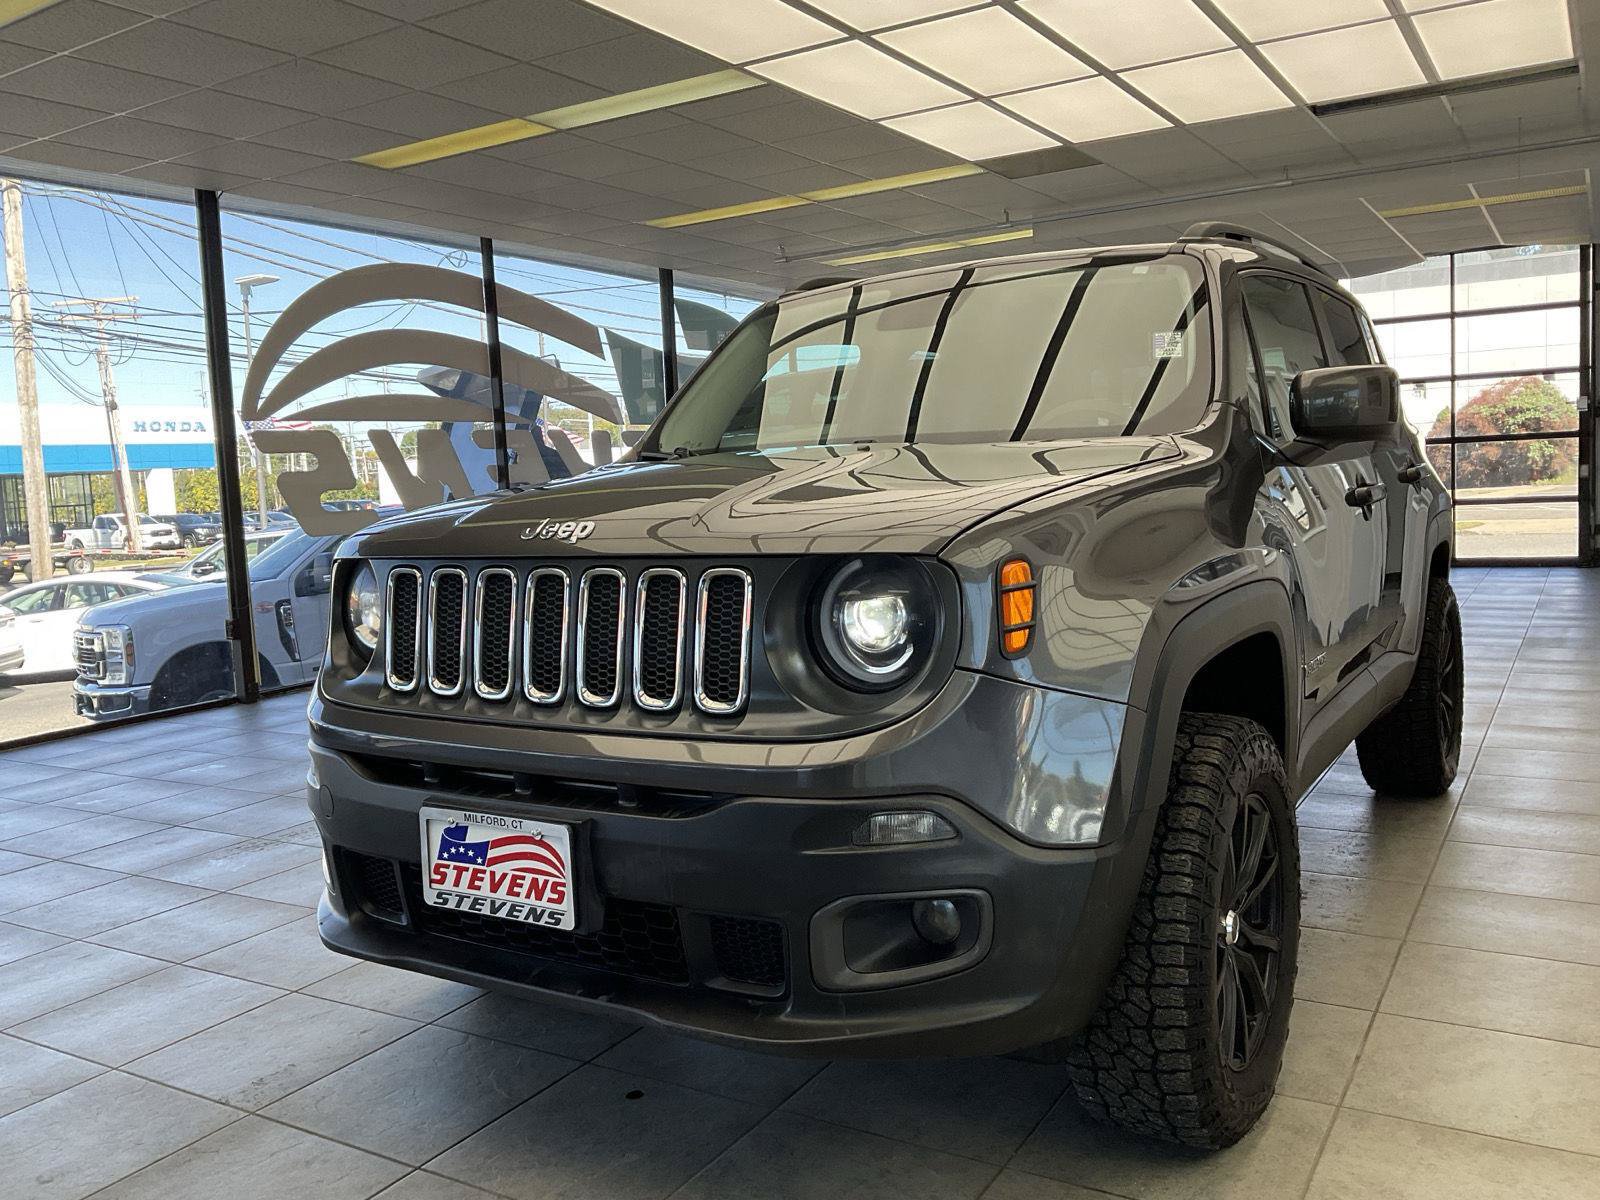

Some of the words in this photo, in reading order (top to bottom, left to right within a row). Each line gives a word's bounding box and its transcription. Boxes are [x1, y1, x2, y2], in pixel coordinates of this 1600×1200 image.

[133, 421, 206, 432] HONDA
[520, 518, 595, 544] Jeep
[463, 813, 509, 829] MILFORD,
[511, 819, 524, 830] CT
[431, 862, 566, 905] STEVENS
[433, 891, 565, 927] STEVENS
